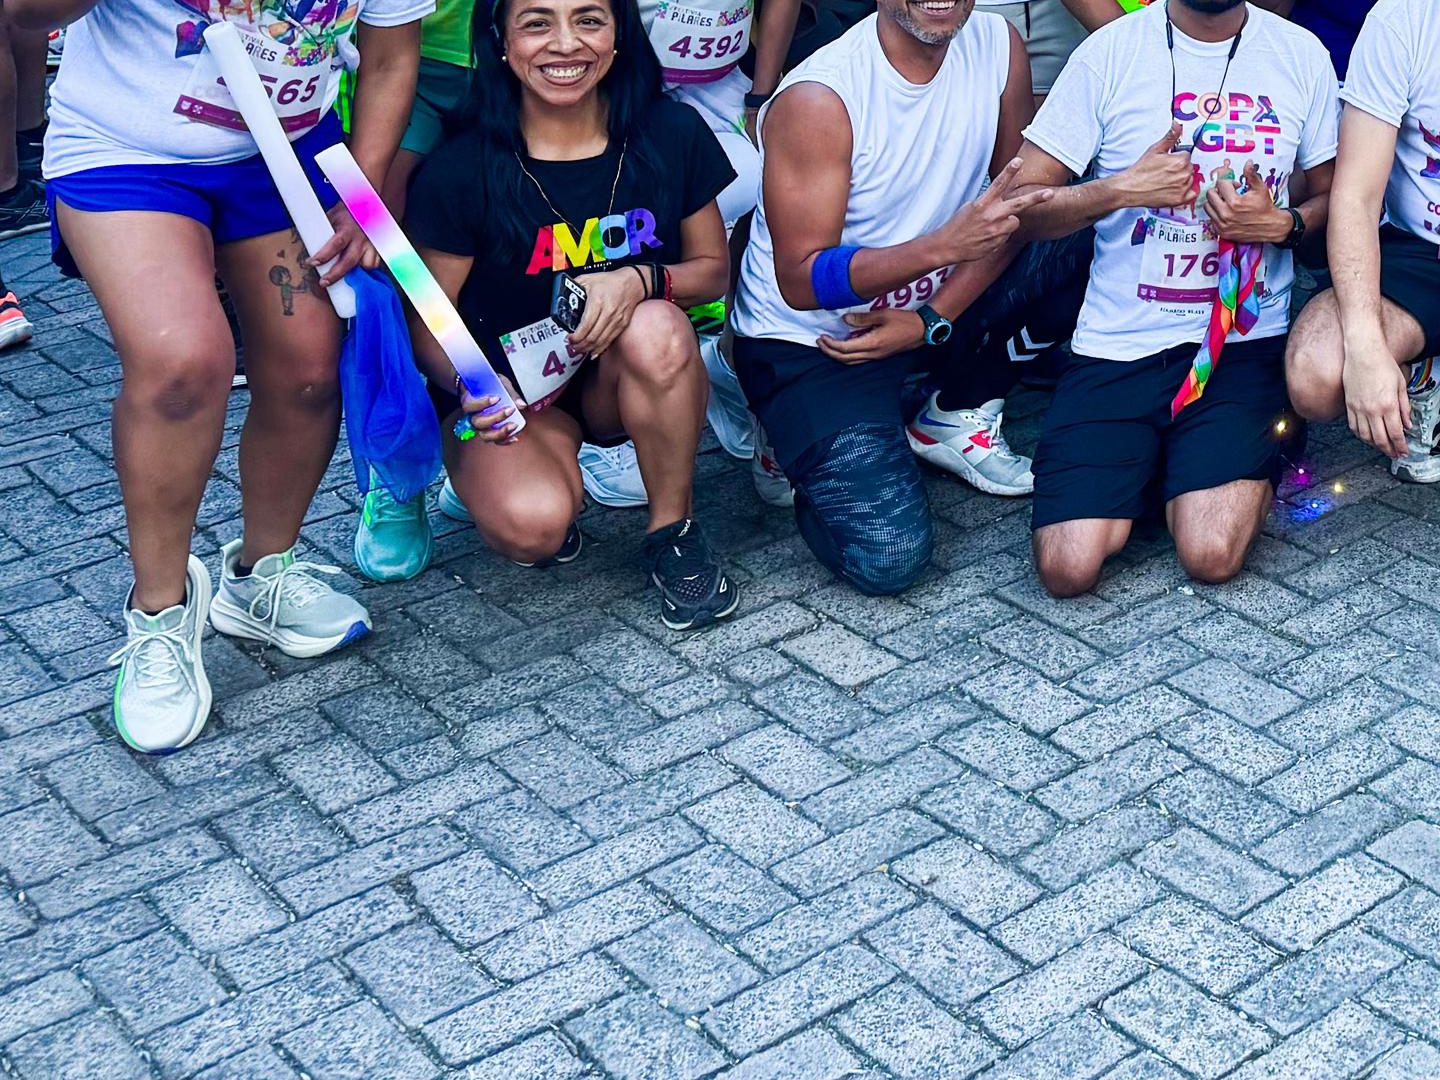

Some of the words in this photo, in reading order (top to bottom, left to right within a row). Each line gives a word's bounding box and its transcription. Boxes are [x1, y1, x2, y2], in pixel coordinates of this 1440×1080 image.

[671, 11, 713, 27] PILARES
[245, 42, 278, 62] ARES
[668, 30, 744, 60] 4392
[1171, 92, 1280, 125] COPA
[525, 207, 664, 275] AMOR
[1158, 230, 1197, 243] PILARES
[1163, 252, 1219, 278] 176
[541, 335, 585, 378] 45
